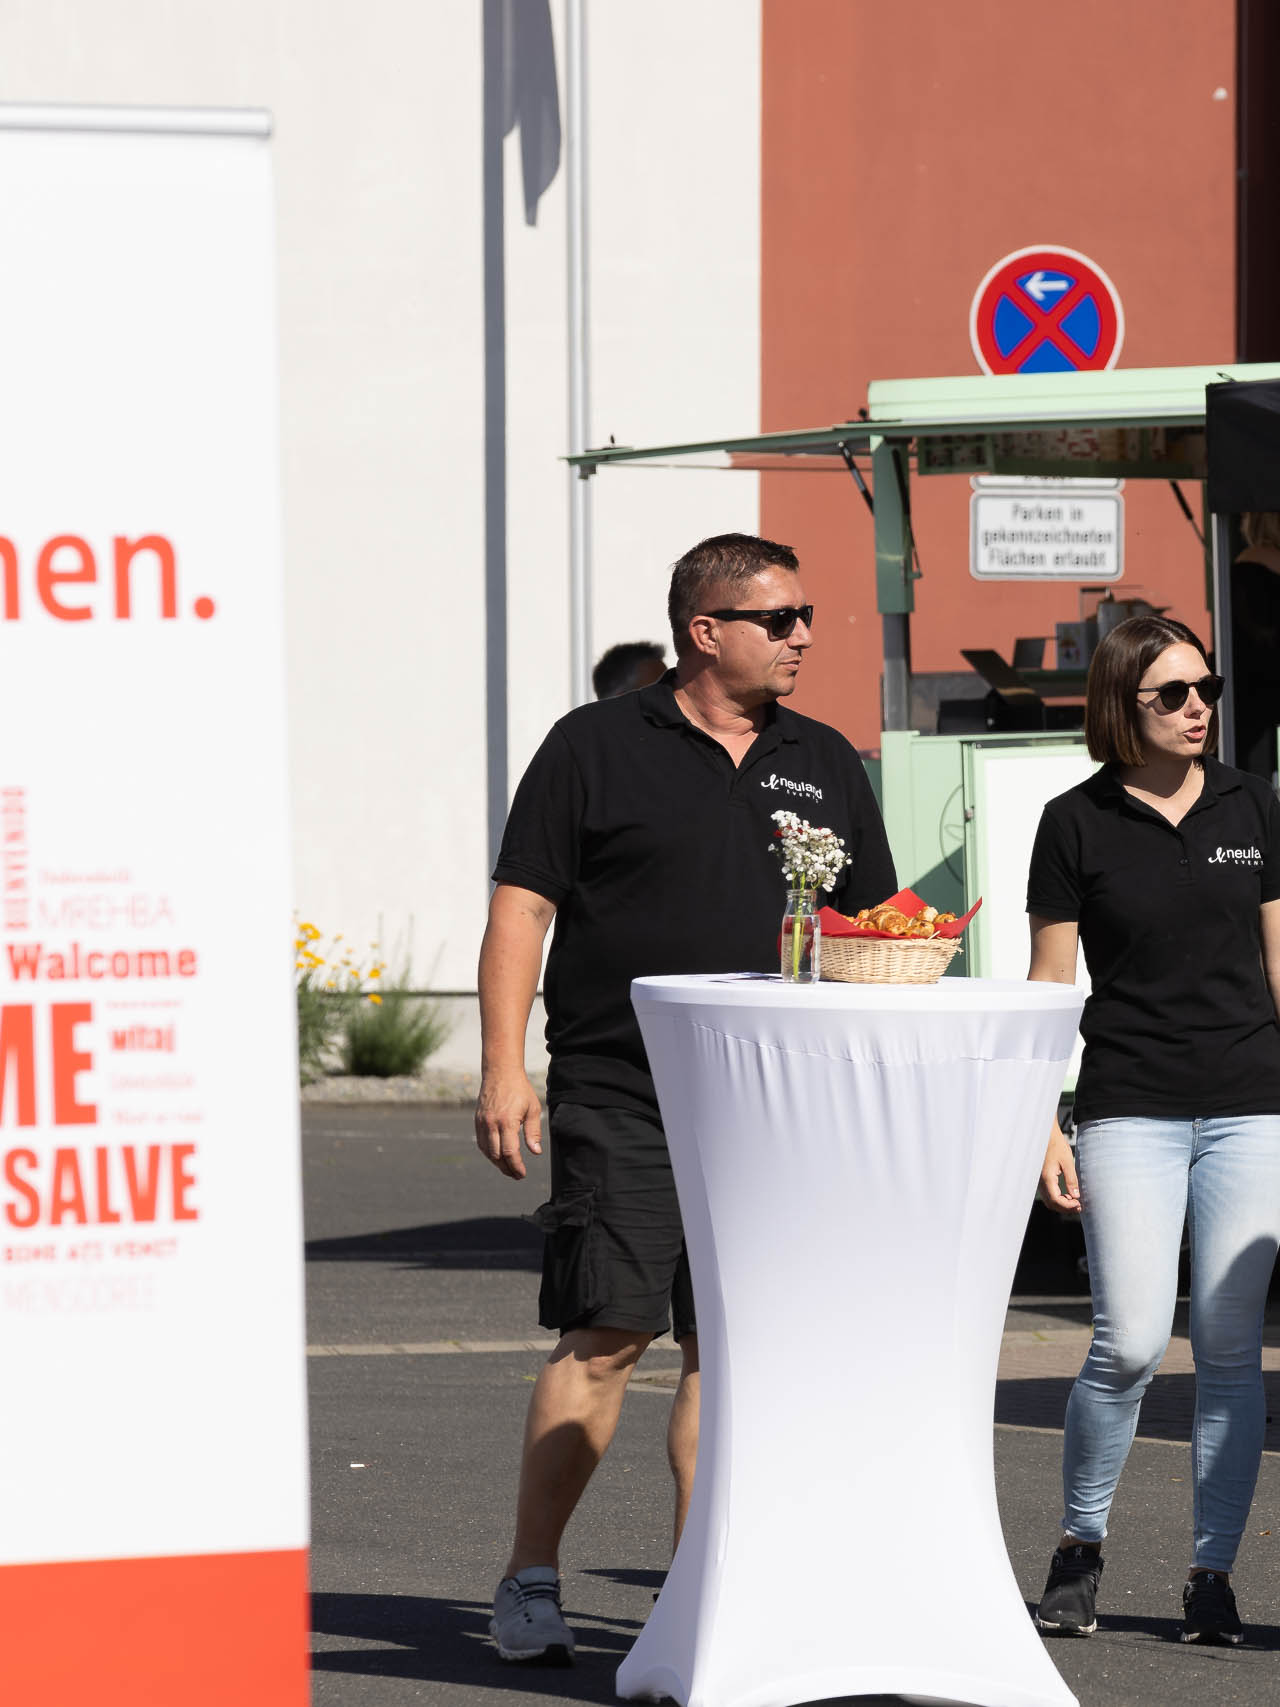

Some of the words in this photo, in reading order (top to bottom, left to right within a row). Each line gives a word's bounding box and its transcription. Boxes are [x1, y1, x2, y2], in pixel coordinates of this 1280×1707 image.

[1012, 503, 1063, 521] Parken
[1071, 505, 1084, 521] in
[983, 527, 1112, 546] gekennzeichneten
[988, 548, 1046, 567] Flächen
[1054, 549, 1107, 567] erlaubt
[4, 1141, 199, 1229] SALVE
